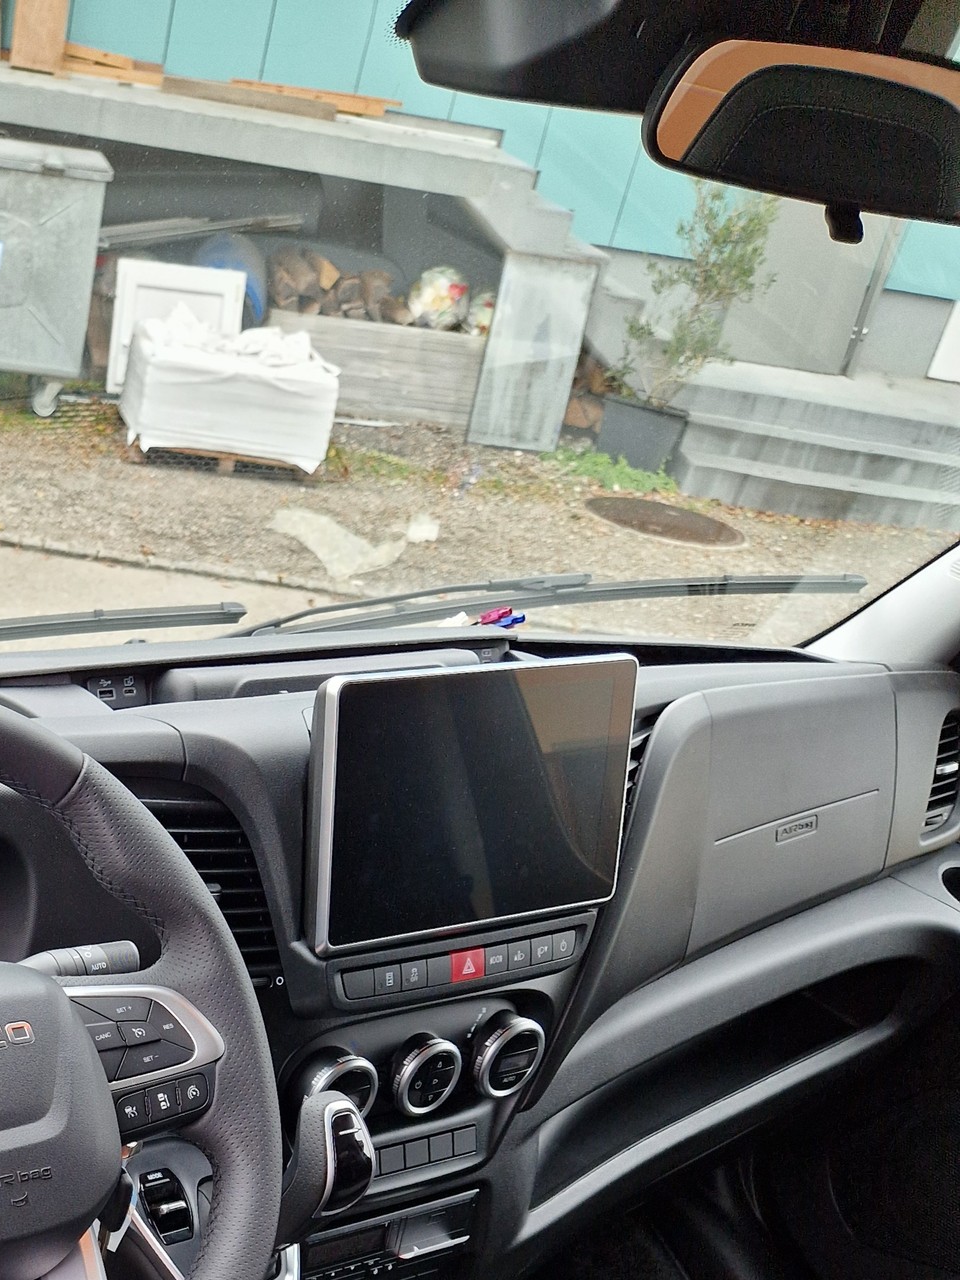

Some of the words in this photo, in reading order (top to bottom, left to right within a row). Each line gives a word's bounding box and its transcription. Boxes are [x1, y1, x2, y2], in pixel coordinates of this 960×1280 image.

[91, 962, 107, 971] AUTO
[95, 1031, 112, 1041] CANC
[143, 1055, 154, 1063] SET
[146, 1171, 164, 1181] MODE
